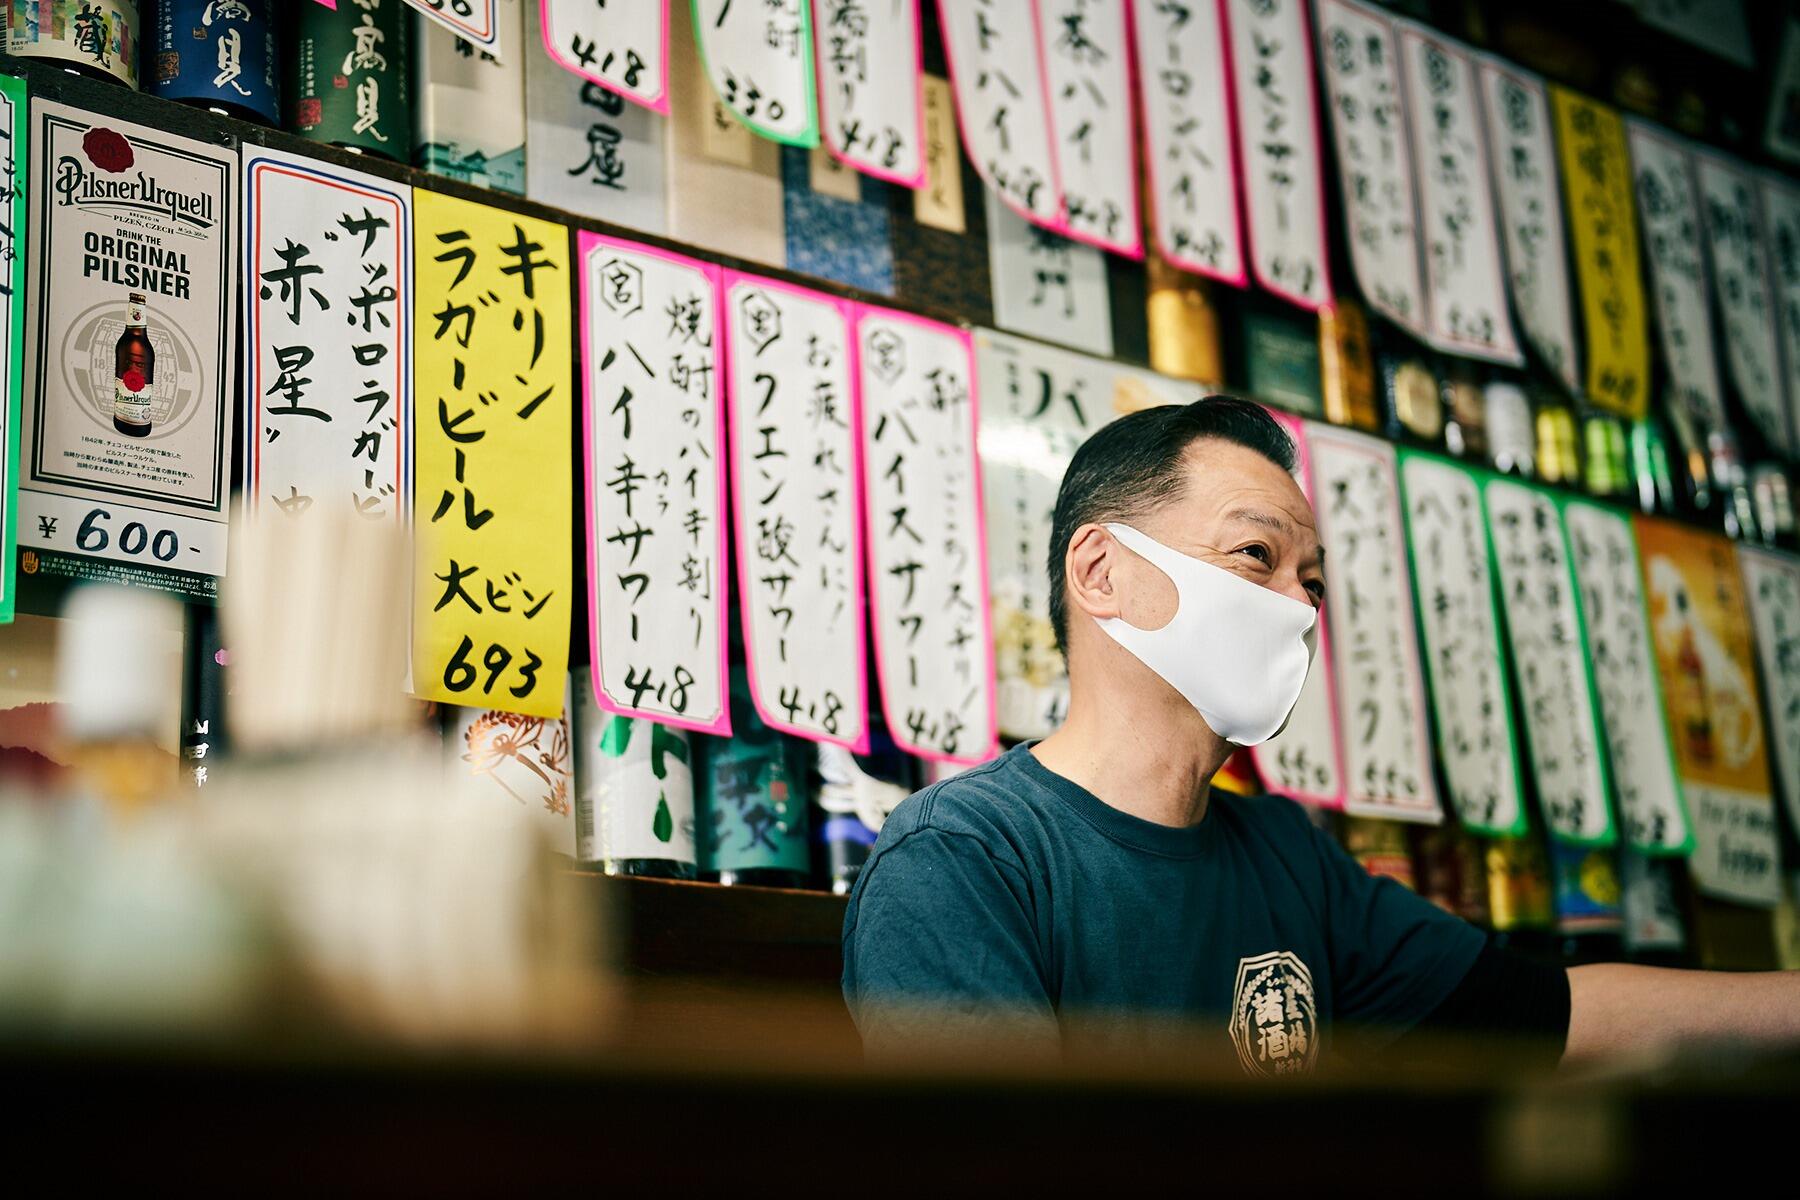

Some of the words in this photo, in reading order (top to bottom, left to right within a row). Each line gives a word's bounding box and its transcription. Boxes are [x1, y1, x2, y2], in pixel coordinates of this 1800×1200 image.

[572, 33, 646, 87] 418
[56, 155, 141, 206] Pilsner
[137, 170, 213, 221] Urquell
[84, 231, 191, 275] ORIGINAL
[117, 228, 143, 242] DRINK
[146, 235, 162, 246] THE
[145, 223, 174, 235] CZECH
[83, 254, 190, 300] PILSNER
[498, 223, 558, 420] キリン
[431, 229, 500, 530] ラガービール
[600, 341, 655, 642] ハイ辛サワー
[753, 373, 800, 663] クエン酸サワー
[38, 515, 59, 539] ¥
[873, 398, 925, 688] バイスサワー
[434, 559, 554, 619] 大ビン
[443, 635, 543, 699] 693
[624, 664, 696, 714] 418
[779, 686, 844, 735] 418
[907, 708, 965, 755] 418
